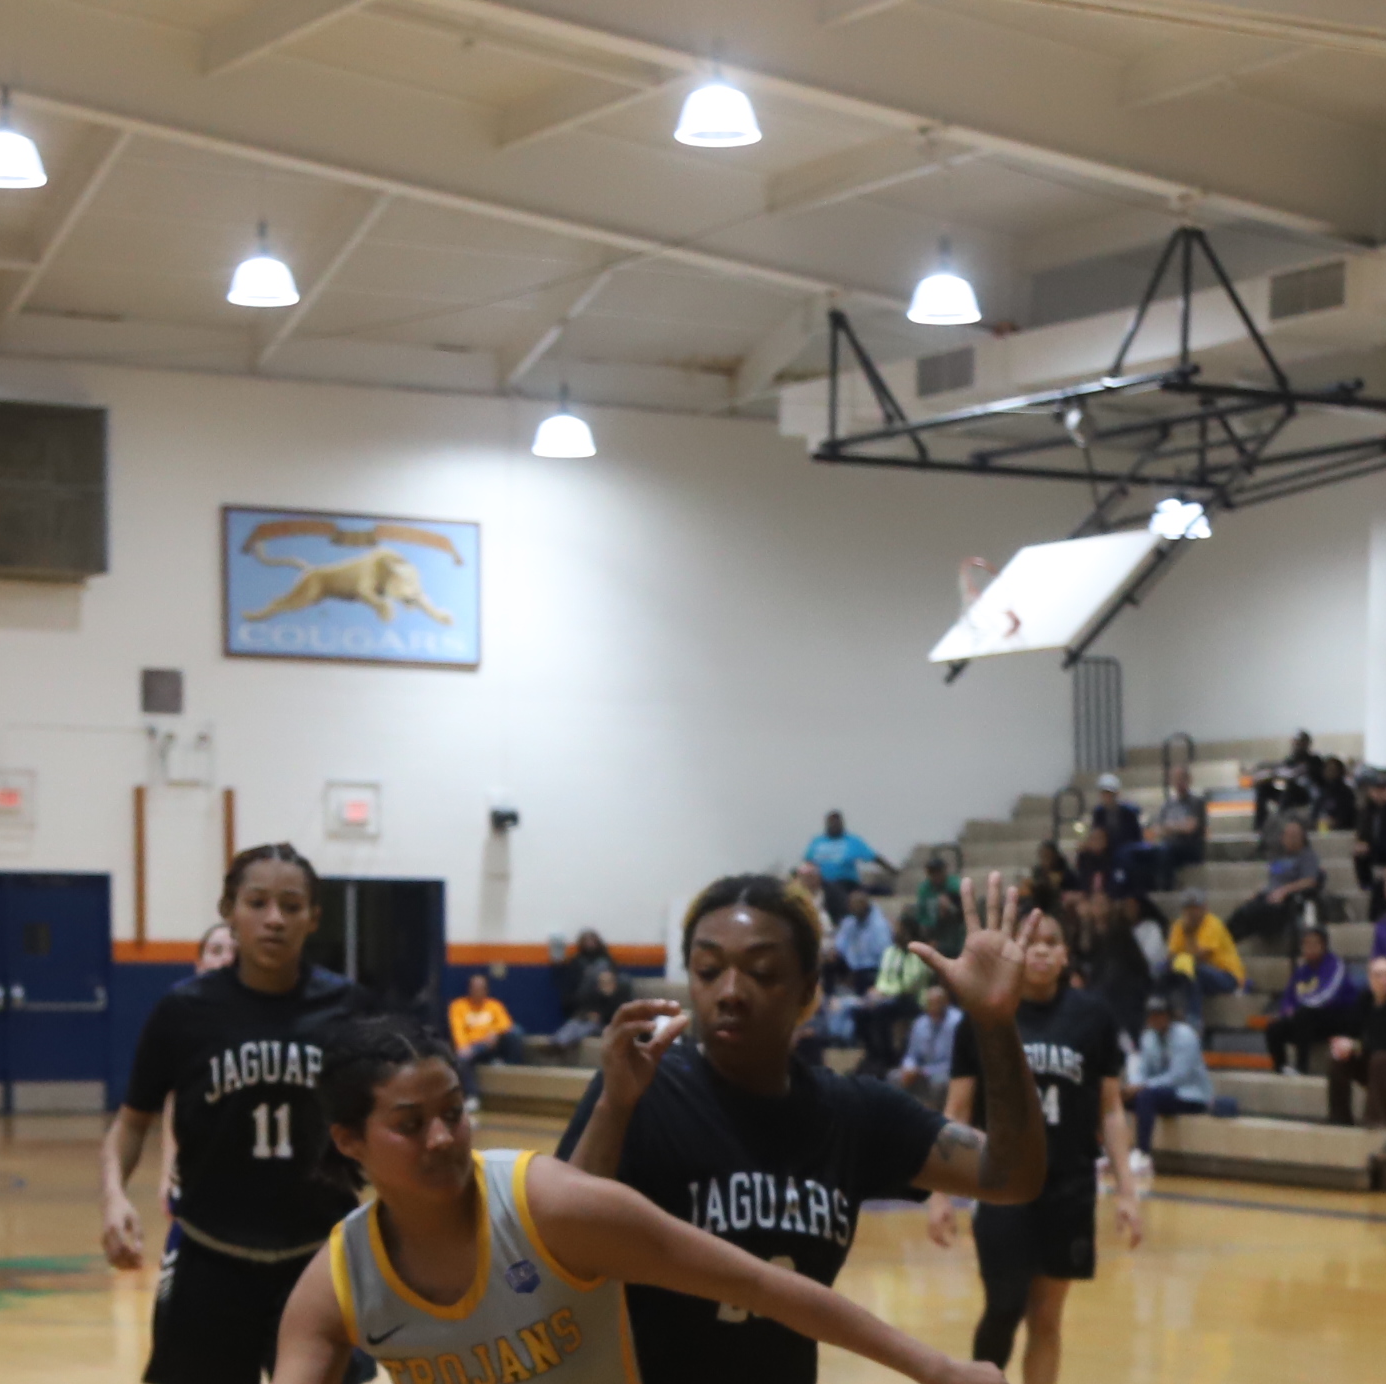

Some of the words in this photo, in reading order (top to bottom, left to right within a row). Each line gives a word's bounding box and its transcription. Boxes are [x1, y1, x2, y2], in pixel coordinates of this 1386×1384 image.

[238, 622, 465, 656] COUGARS
[252, 1102, 294, 1159] 11
[688, 1171, 850, 1247] JAGUARS
